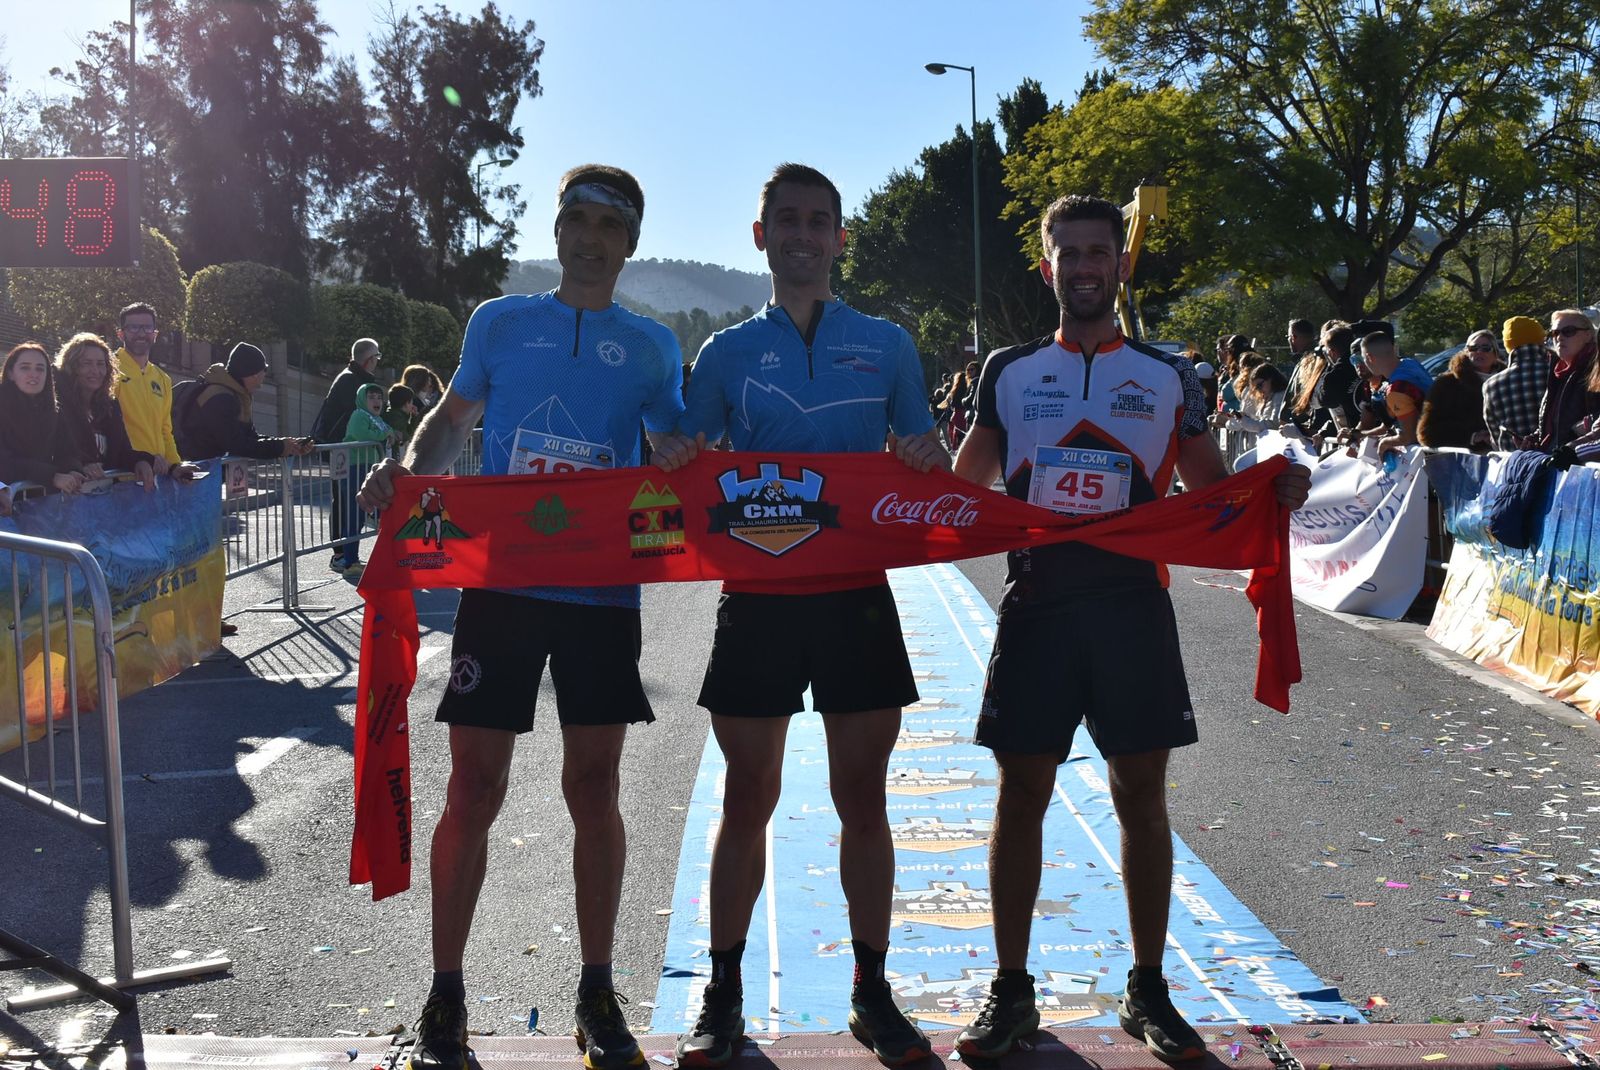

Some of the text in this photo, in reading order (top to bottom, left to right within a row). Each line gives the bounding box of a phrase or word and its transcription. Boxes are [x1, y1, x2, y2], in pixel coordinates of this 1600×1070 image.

[1117, 394, 1145, 402] FUENTE
[1118, 402, 1155, 414] ACEBUCHE
[543, 438, 560, 451] XII
[563, 442, 592, 457] CXM
[1062, 451, 1108, 465] XII CXM
[1055, 471, 1105, 500] 45
[871, 492, 981, 527] Coca-Cola
[628, 508, 684, 532] CXM
[634, 532, 682, 546] TRAIL
[631, 545, 687, 559] ANDALUCÍA
[935, 801, 961, 810] del
